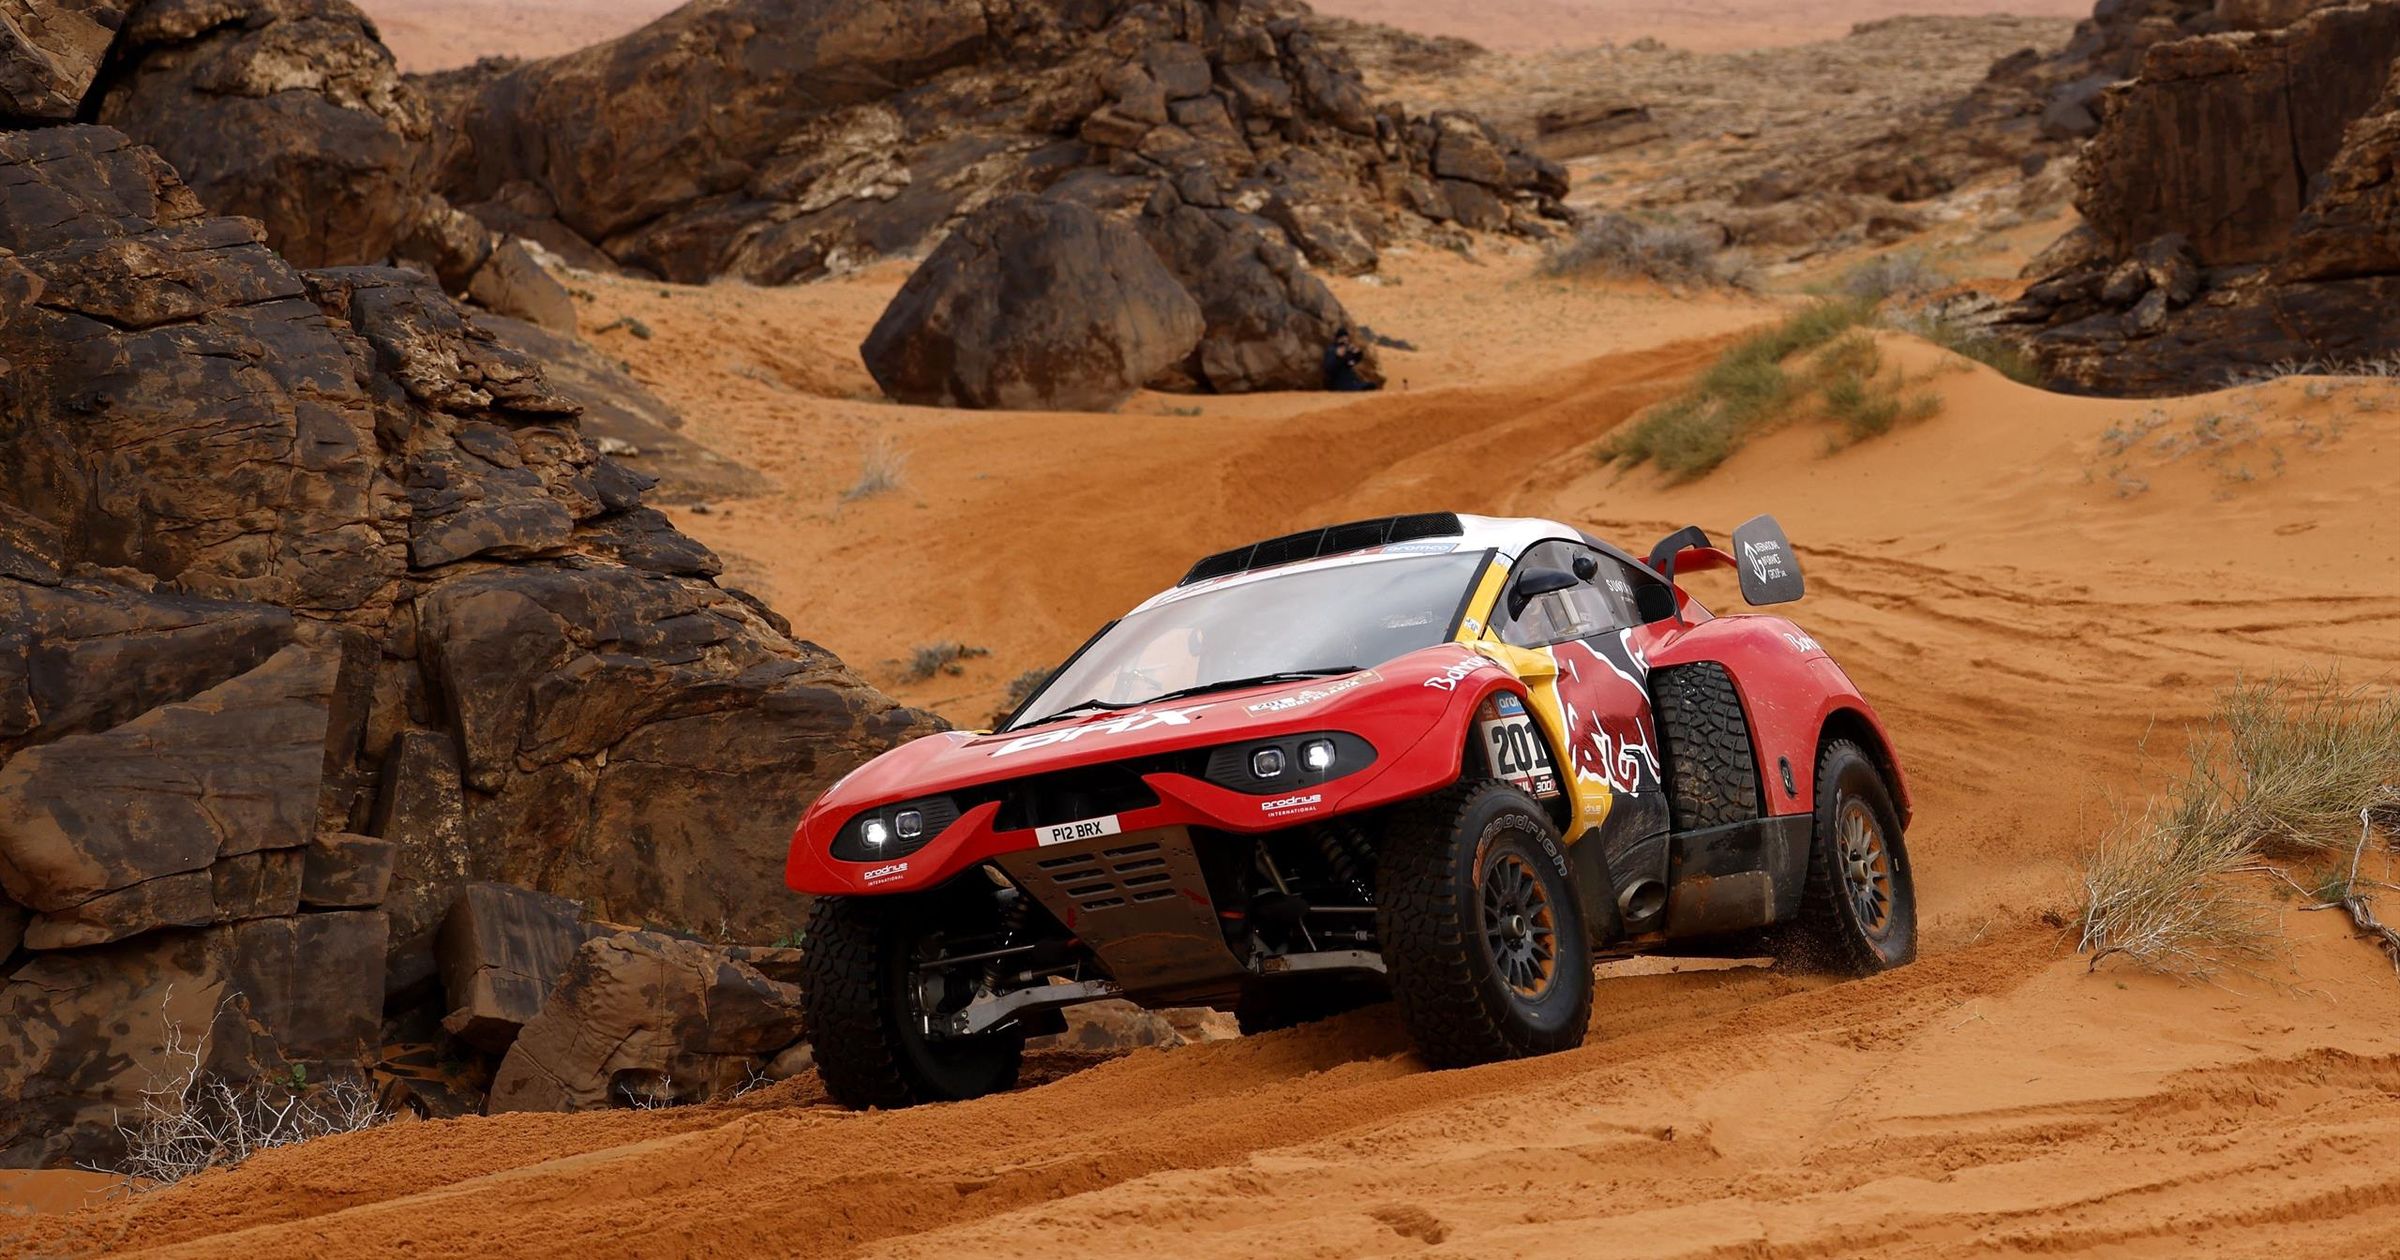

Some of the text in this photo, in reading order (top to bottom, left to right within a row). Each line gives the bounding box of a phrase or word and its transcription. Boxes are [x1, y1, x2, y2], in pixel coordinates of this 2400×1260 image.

[1491, 722, 1551, 775] 201
[1262, 794, 1322, 811] prodrive
[1268, 806, 1317, 818] INTERNATIONAL
[1052, 821, 1103, 842] P12 BRX
[864, 862, 908, 880] prodrive
